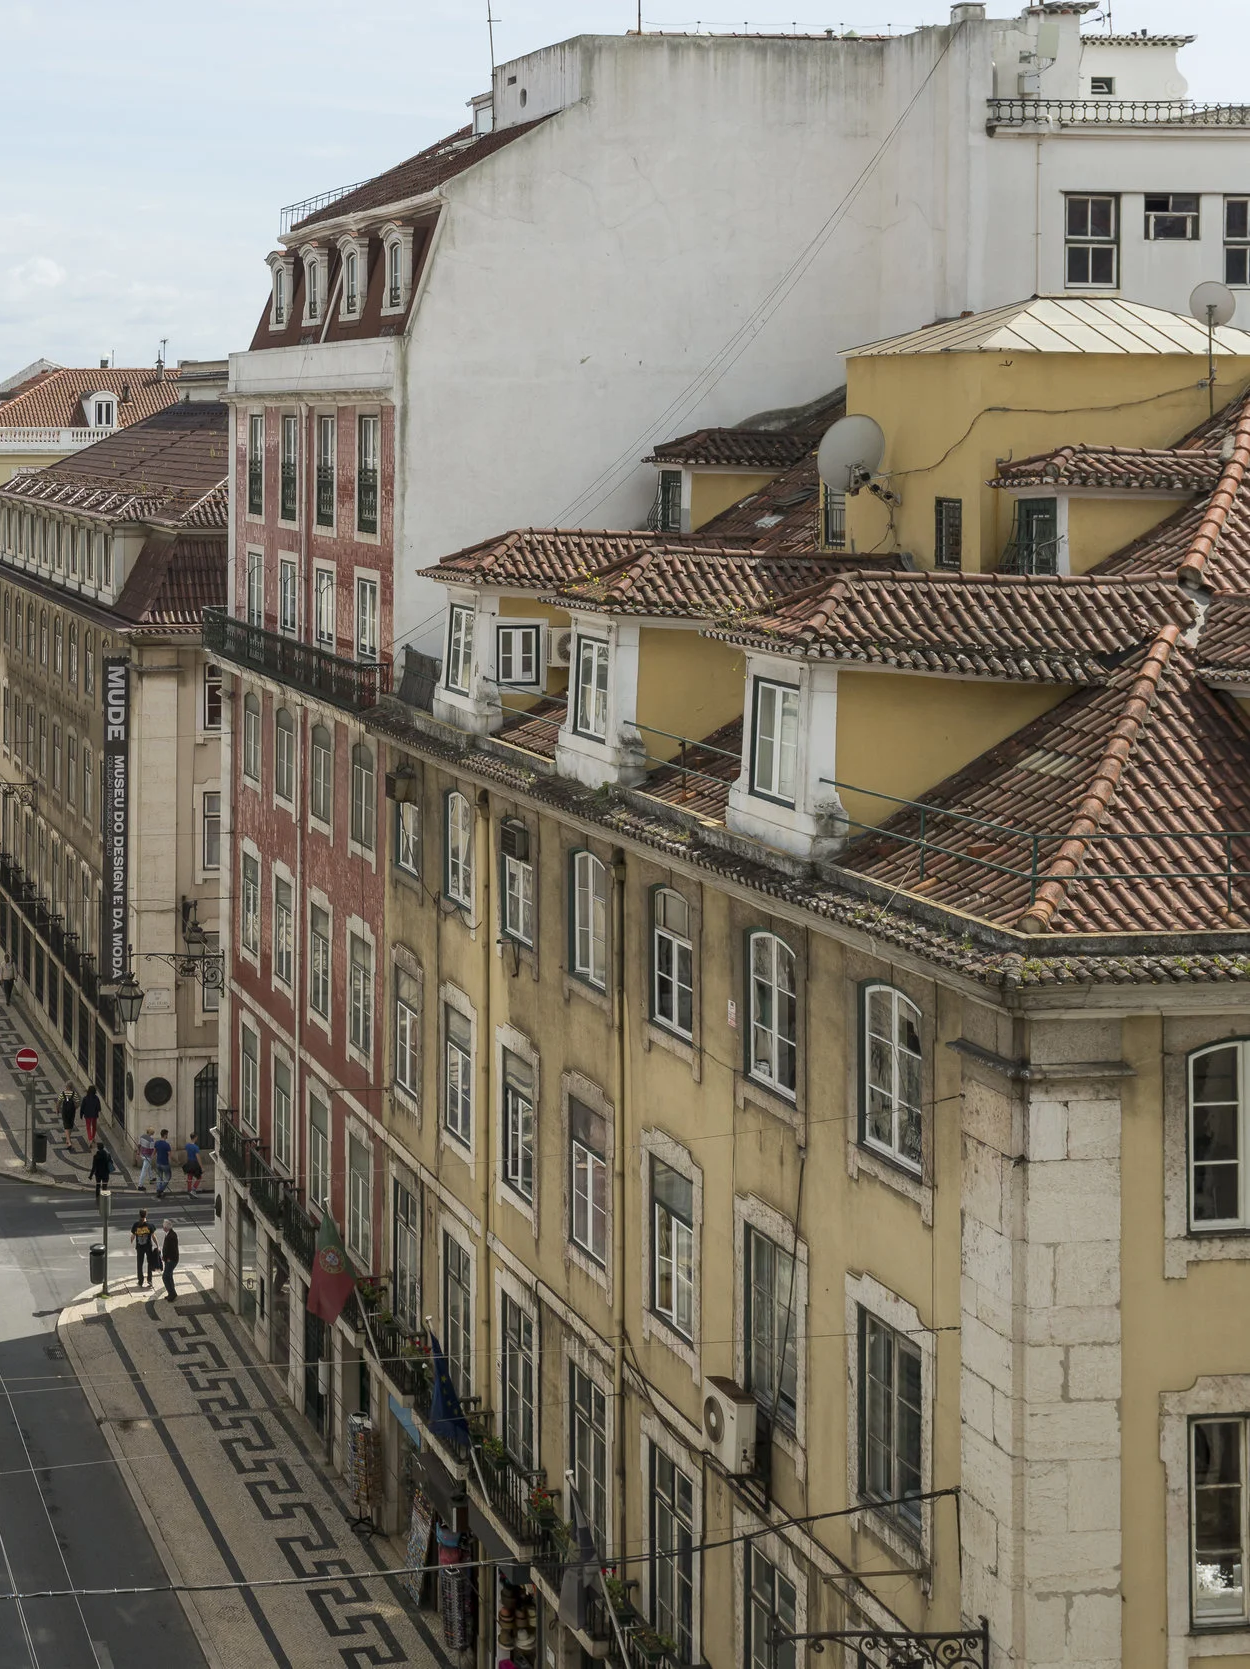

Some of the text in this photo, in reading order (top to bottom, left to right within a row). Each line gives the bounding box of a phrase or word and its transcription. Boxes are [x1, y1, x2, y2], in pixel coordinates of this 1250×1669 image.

[108, 666, 125, 741] MUDE
[112, 755, 125, 979] MUSEU DO DESIGN E DA MODA
